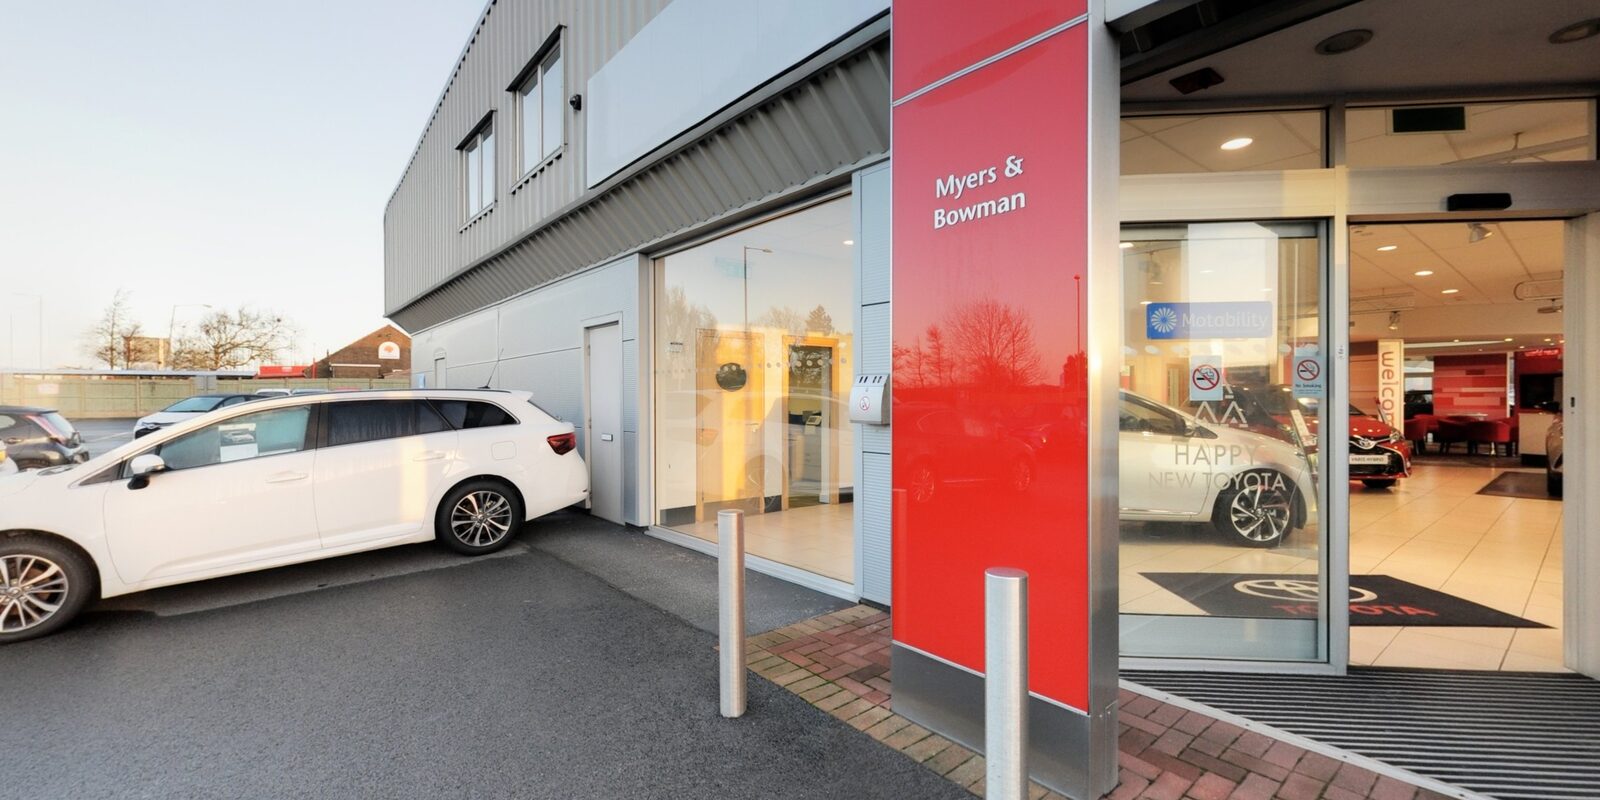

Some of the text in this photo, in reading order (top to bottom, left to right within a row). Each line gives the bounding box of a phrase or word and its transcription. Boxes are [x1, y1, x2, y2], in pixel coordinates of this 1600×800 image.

[935, 155, 1024, 200] Myers &
[933, 191, 1026, 230] Bowman
[1182, 311, 1269, 331] Motability
[1381, 351, 1399, 428] welcom
[1175, 444, 1259, 466] HAPPY
[1148, 472, 1287, 492] NEW TOYOTA
